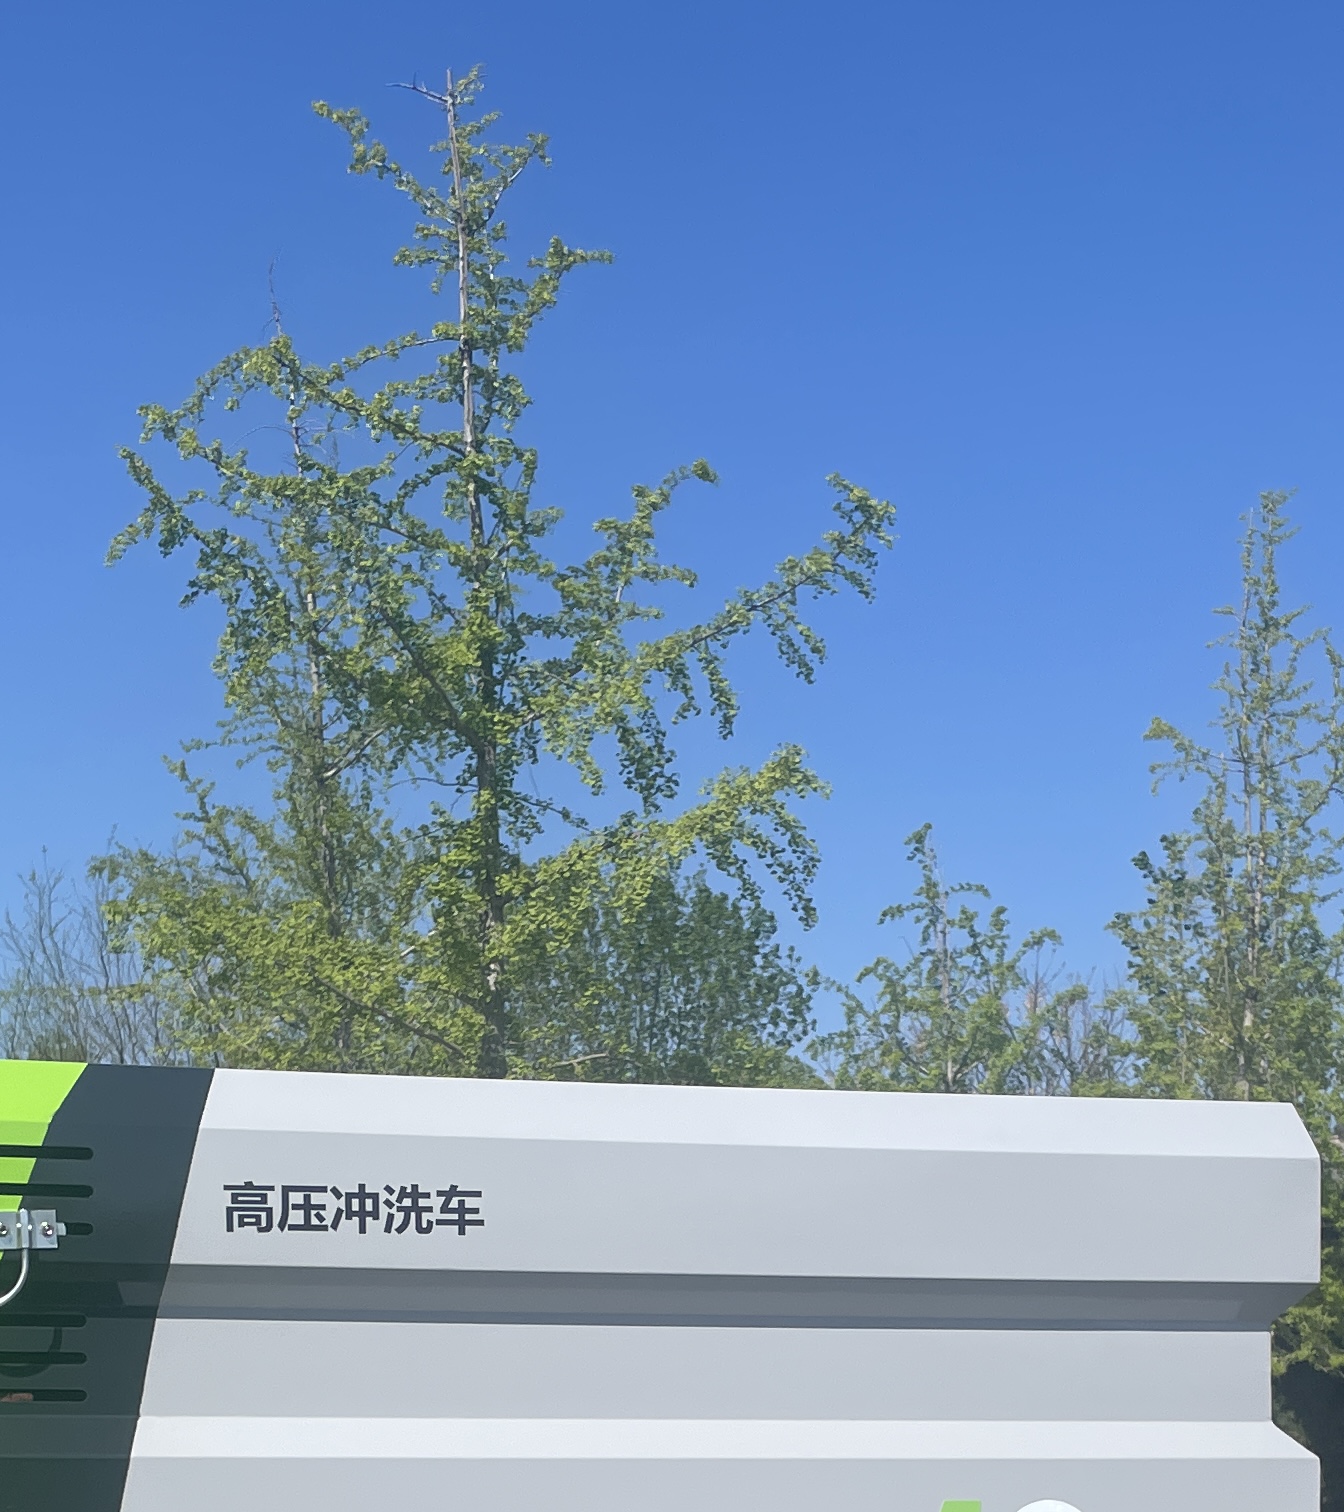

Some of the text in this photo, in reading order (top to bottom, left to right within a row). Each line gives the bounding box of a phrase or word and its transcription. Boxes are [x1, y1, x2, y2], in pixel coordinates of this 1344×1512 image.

[223, 1181, 485, 1236] 高压冲洗车
